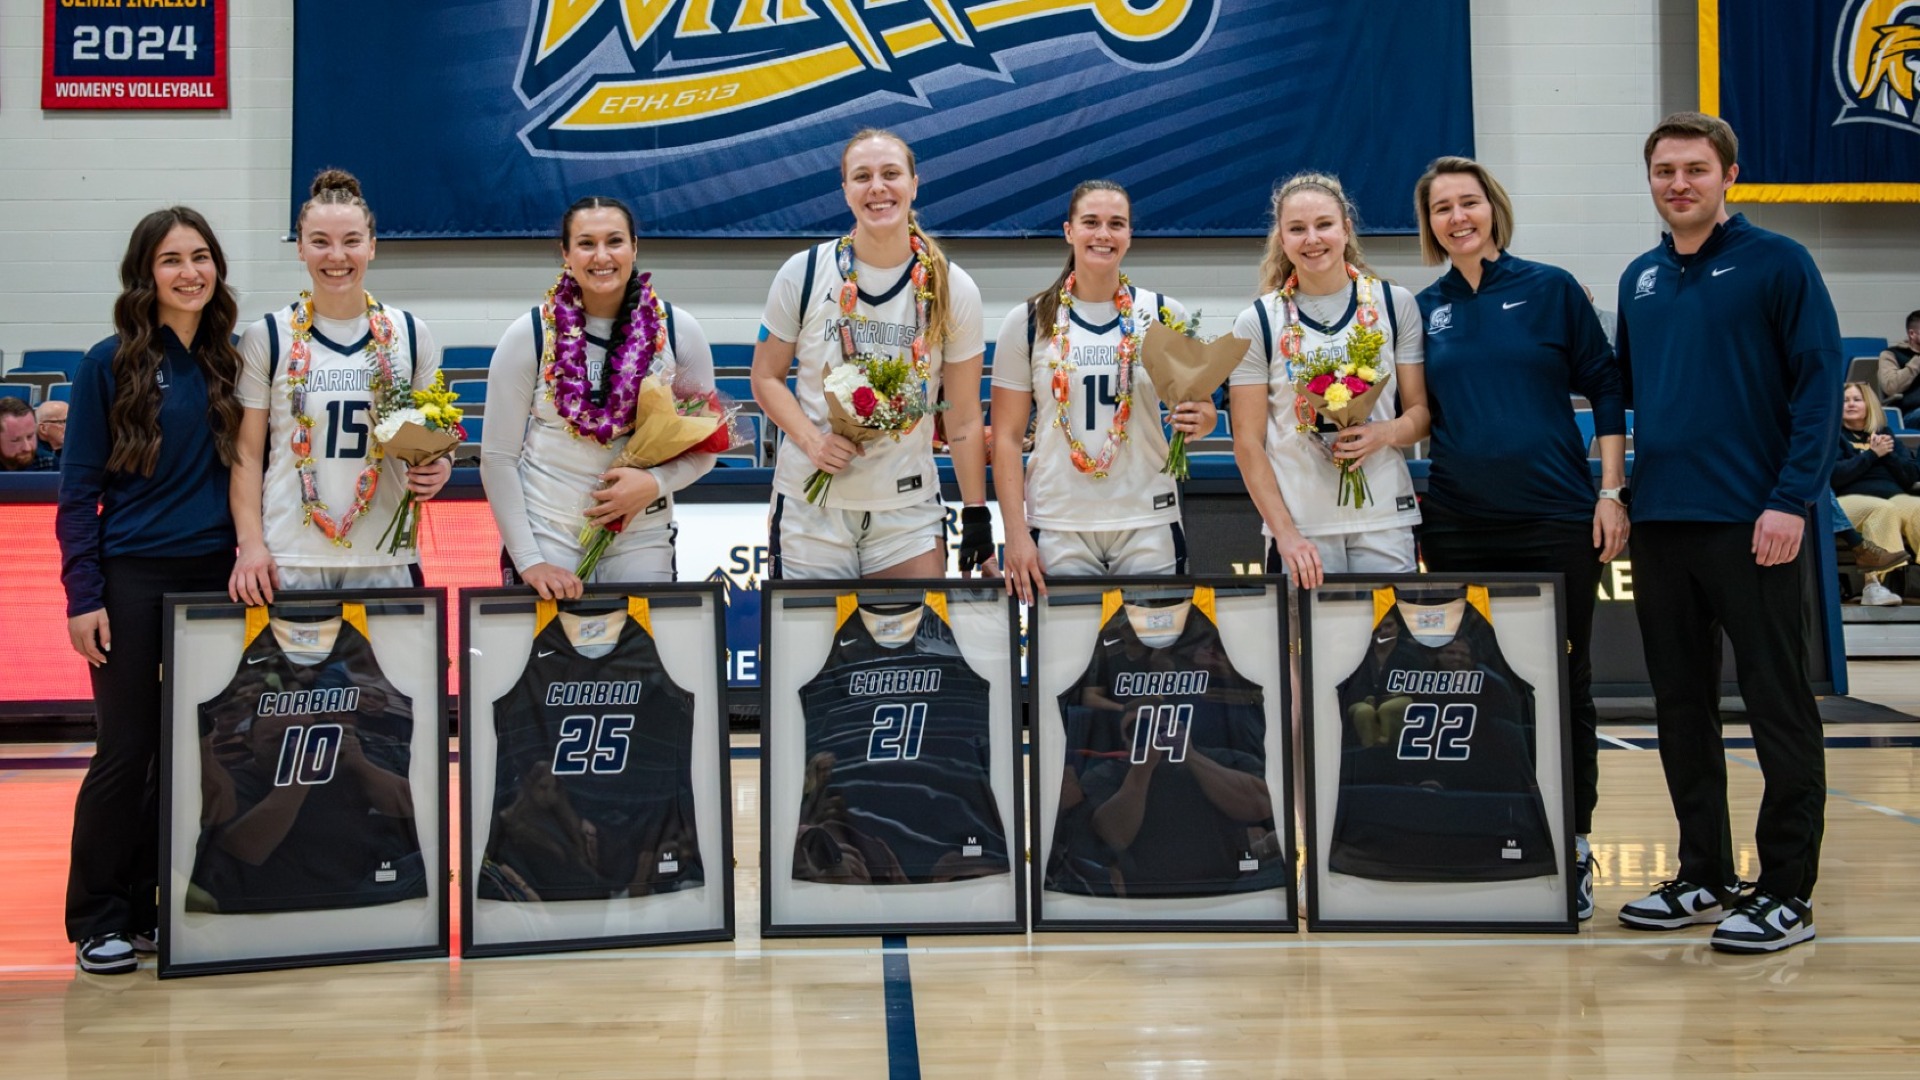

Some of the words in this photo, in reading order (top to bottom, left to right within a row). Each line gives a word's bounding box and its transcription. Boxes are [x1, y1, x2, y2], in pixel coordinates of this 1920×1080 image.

[73, 25, 197, 60] 2024
[55, 82, 124, 98] WOMEN'S
[128, 82, 214, 98] VOLLEYBALL
[598, 82, 740, 114] EPH.6:13
[1082, 374, 1120, 431] 14
[325, 400, 372, 459] 15
[546, 680, 642, 706] CORBAN
[849, 668, 942, 696] CORBAN
[1114, 670, 1209, 696] CORBAN
[1386, 669, 1484, 694] CORBAN
[257, 686, 360, 717] CORBAN
[551, 714, 635, 775] 25
[866, 702, 928, 762] 21
[1130, 703, 1194, 765] 14
[1396, 702, 1478, 761] 22
[273, 723, 344, 787] 10
[967, 836, 977, 845] M
[1244, 851, 1252, 859] L
[1506, 839, 1517, 848] M
[381, 861, 391, 869] M
[663, 852, 673, 861] M
